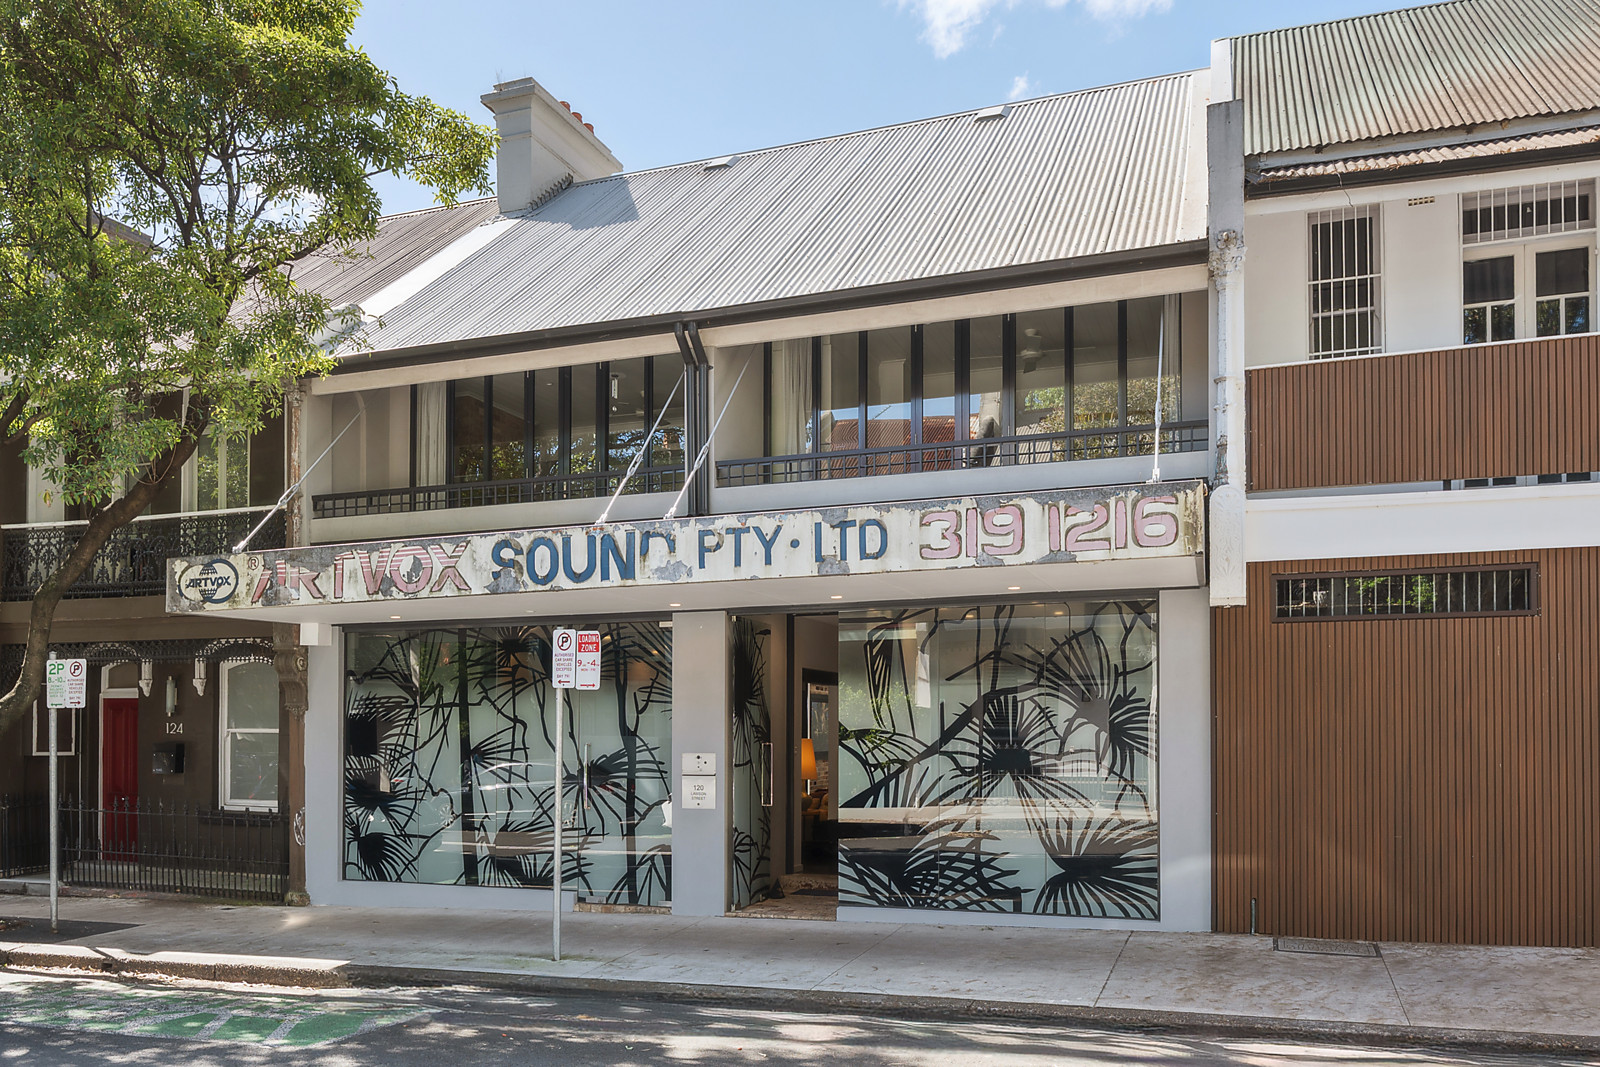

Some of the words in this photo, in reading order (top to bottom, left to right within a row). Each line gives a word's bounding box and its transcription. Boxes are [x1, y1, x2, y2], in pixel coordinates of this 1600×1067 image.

[813, 517, 888, 563] LTD
[919, 504, 1026, 560] 319
[1048, 494, 1180, 553] 1216
[185, 576, 232, 590] ARTVOX
[578, 635, 599, 643] LOADING
[48, 663, 64, 675] 2P
[165, 722, 184, 734] 124
